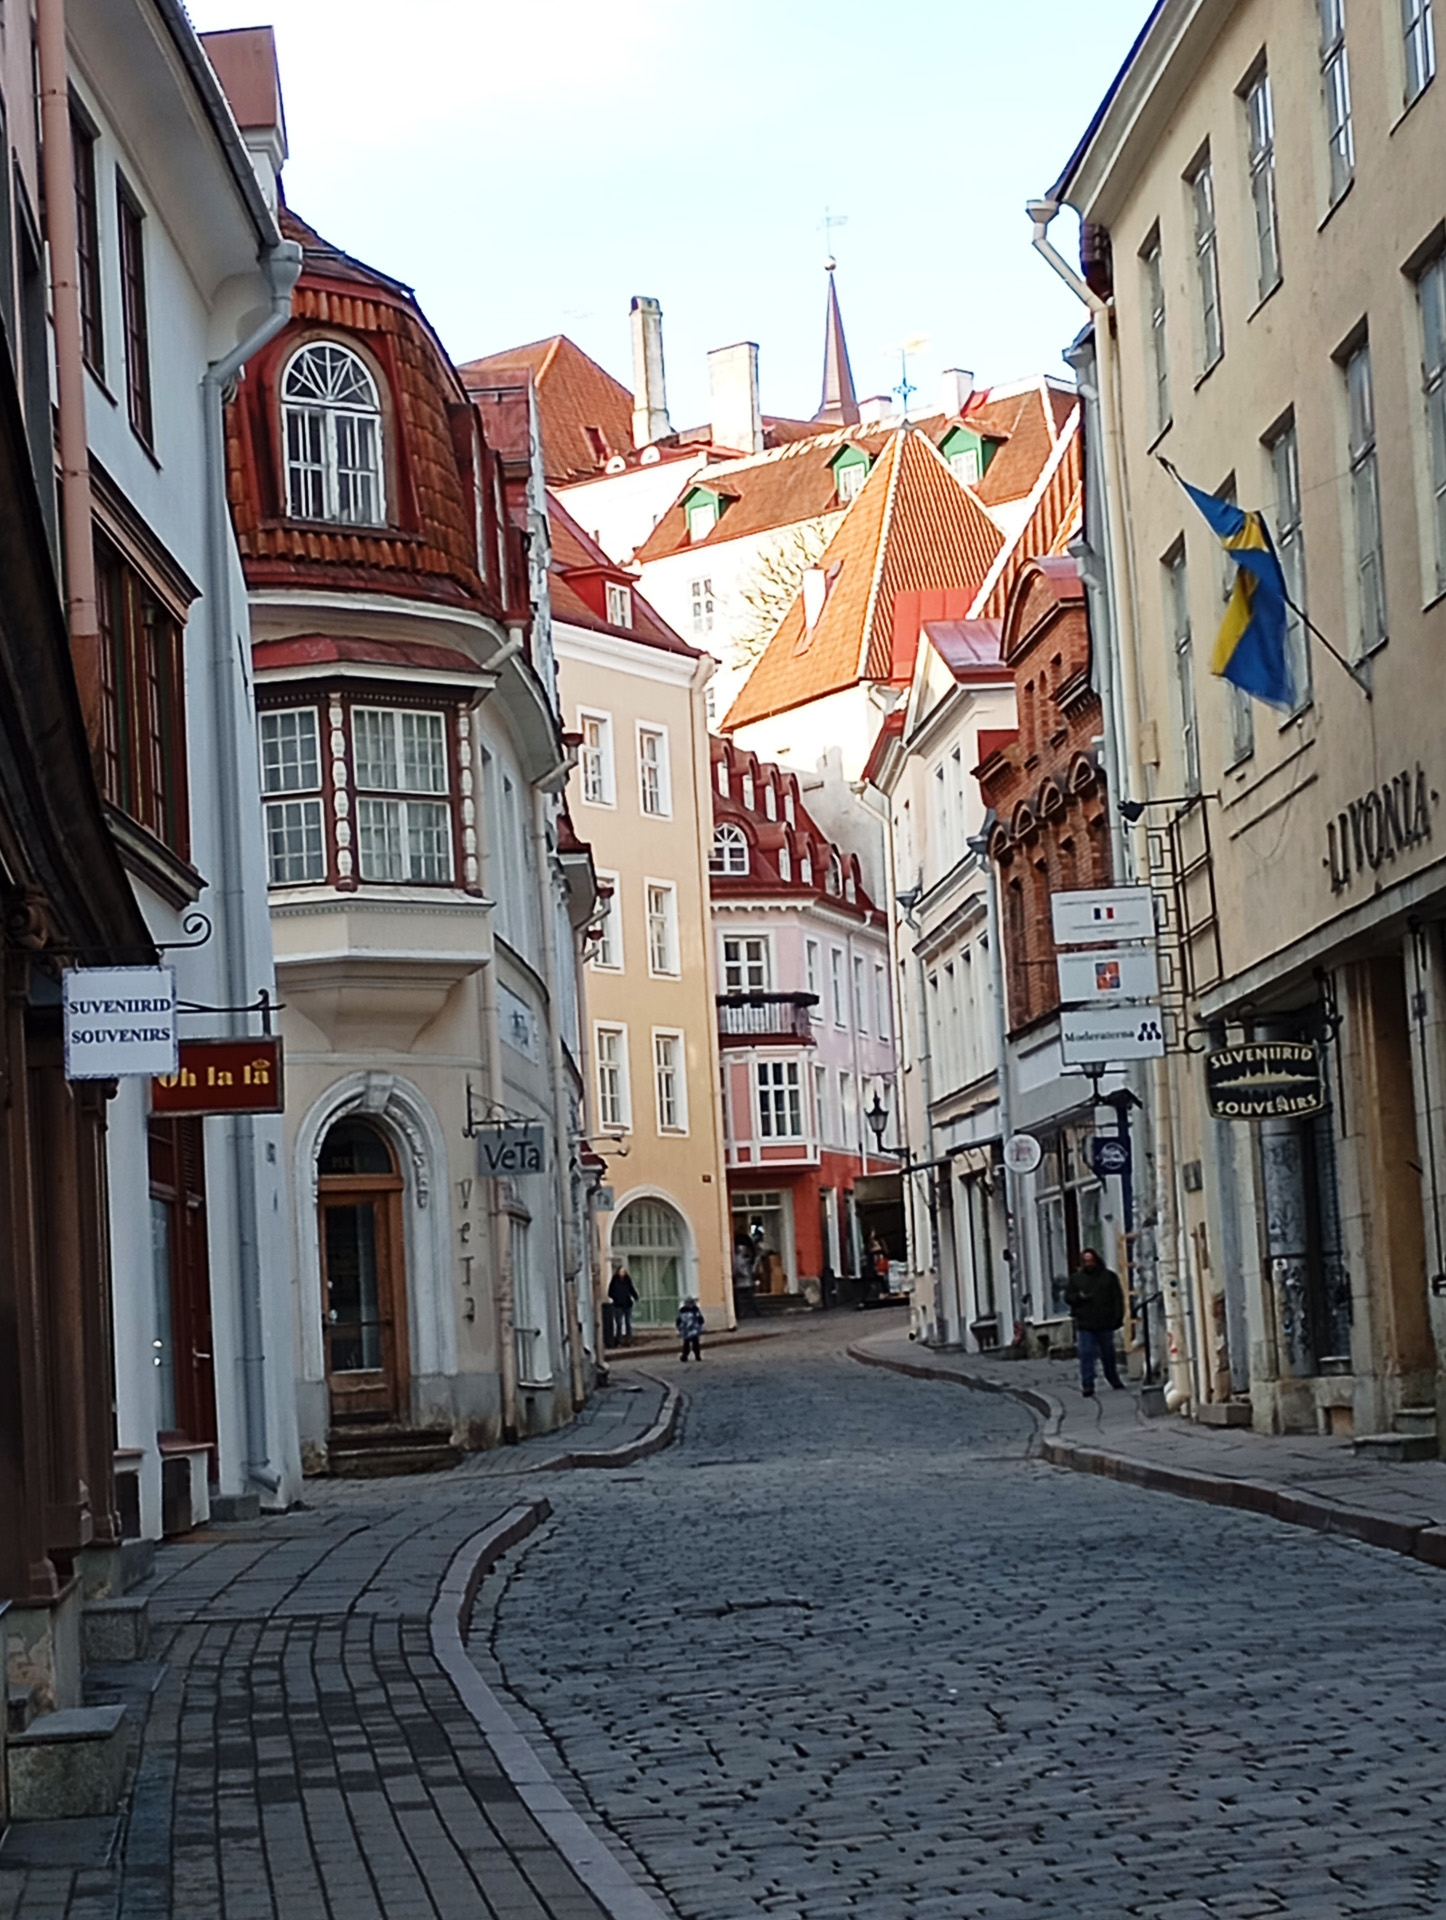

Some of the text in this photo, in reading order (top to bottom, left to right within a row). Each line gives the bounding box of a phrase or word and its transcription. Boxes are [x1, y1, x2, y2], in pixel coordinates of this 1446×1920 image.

[69, 998, 171, 1015] SUVENIIRID
[71, 1027, 170, 1044] SOUVENIRS
[1210, 1047, 1312, 1069] SUVENIIRID
[207, 1066, 233, 1086] la
[483, 1141, 541, 1171] VeTa
[454, 1178, 475, 1323] VeTa
